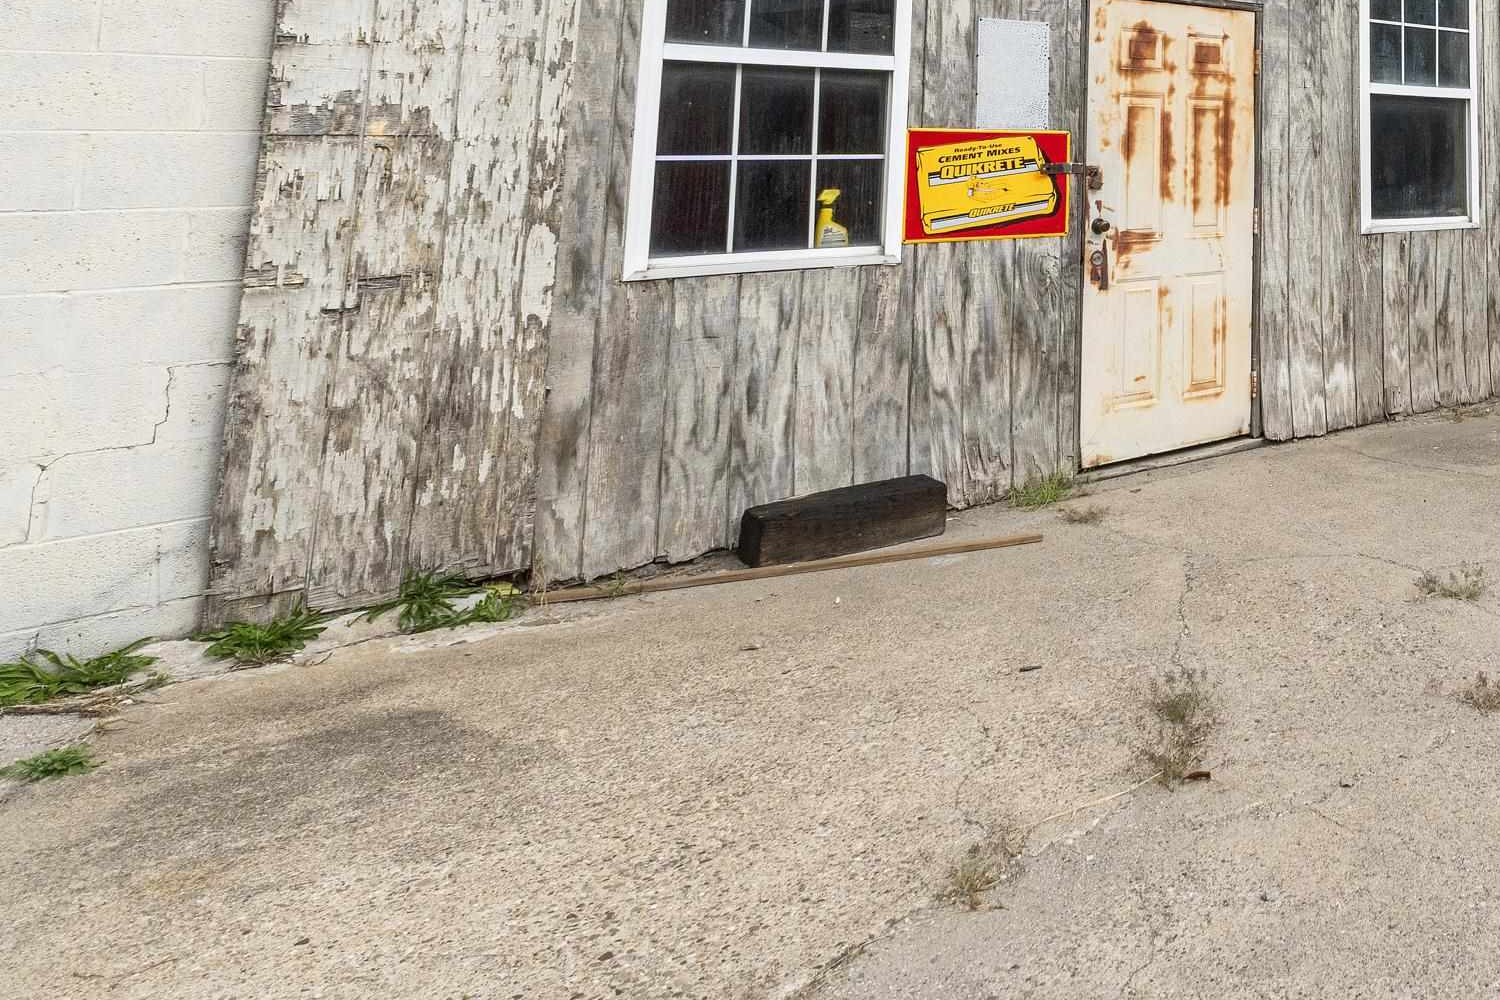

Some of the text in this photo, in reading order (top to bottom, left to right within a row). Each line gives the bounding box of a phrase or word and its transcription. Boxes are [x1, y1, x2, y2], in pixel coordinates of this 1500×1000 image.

[938, 147, 1020, 163] CEMENT MIXES
[940, 157, 1025, 179] QUIKRETE
[968, 202, 1016, 218] QUIKRETE
